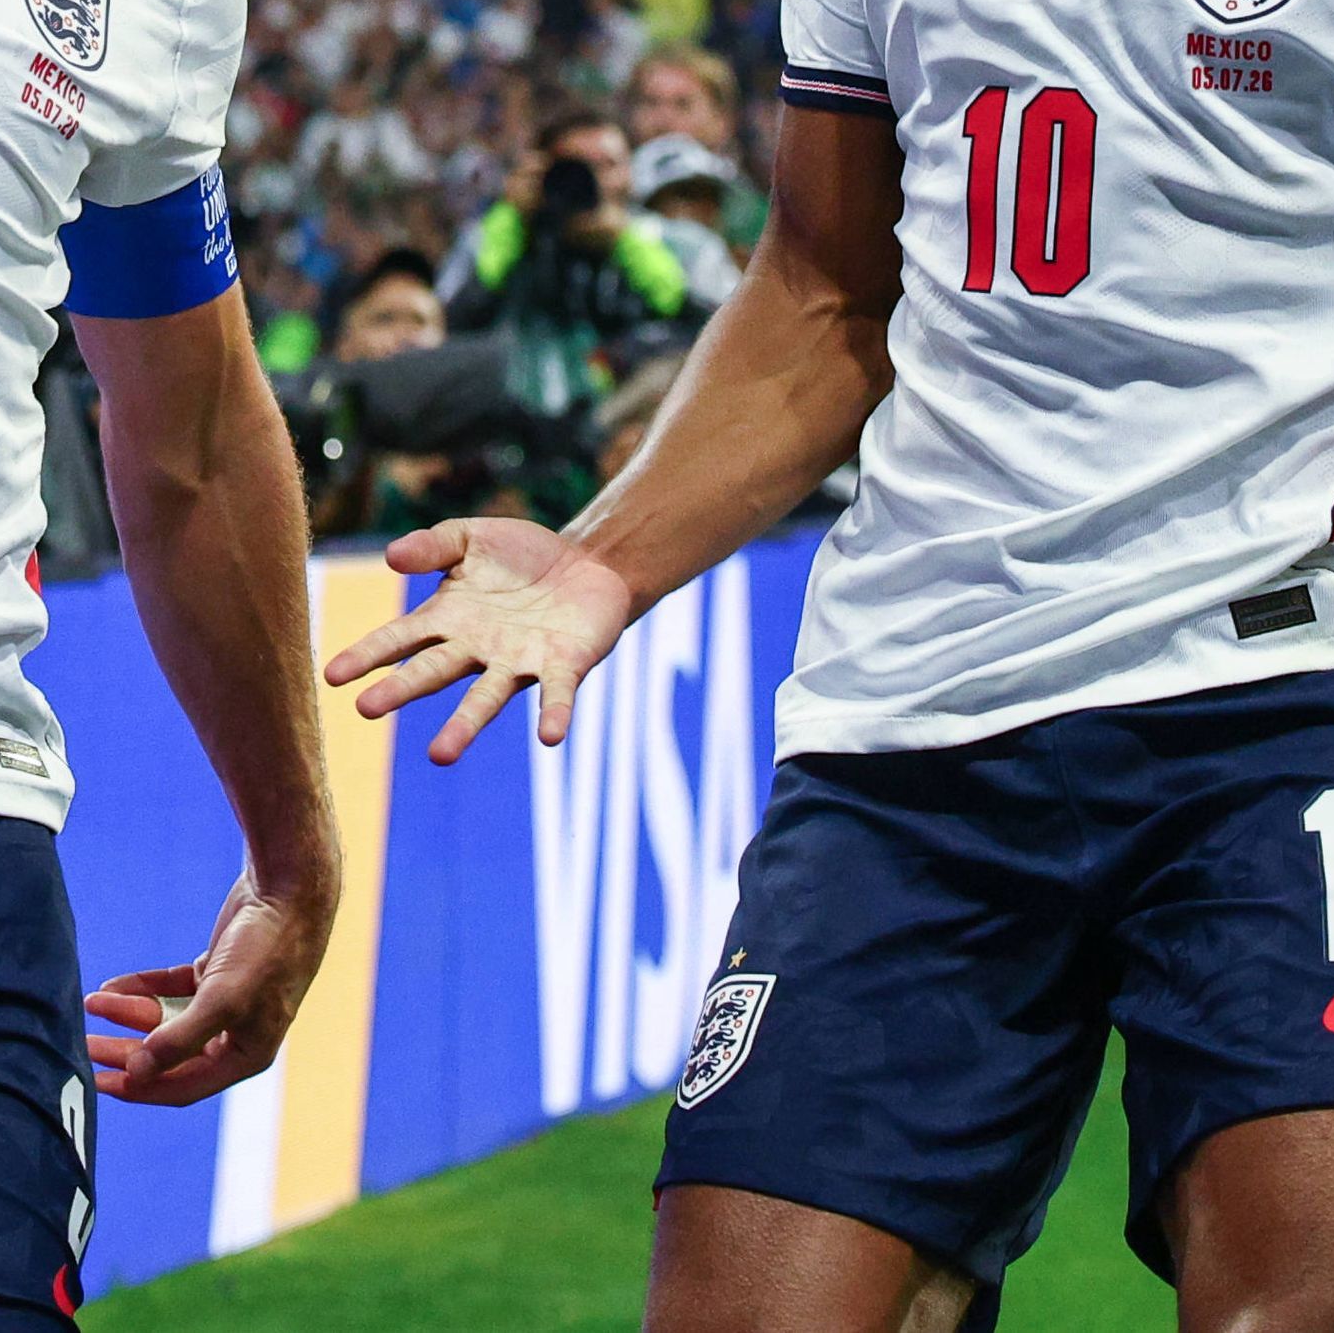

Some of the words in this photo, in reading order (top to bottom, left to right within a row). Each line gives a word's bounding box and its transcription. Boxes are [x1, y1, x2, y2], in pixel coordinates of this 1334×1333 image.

[1186, 32, 1272, 62] MEXICO
[30, 52, 86, 114] MEXICO
[1192, 66, 1273, 92] 05.07.26
[962, 86, 1097, 297] 10
[528, 552, 758, 1116] VISA
